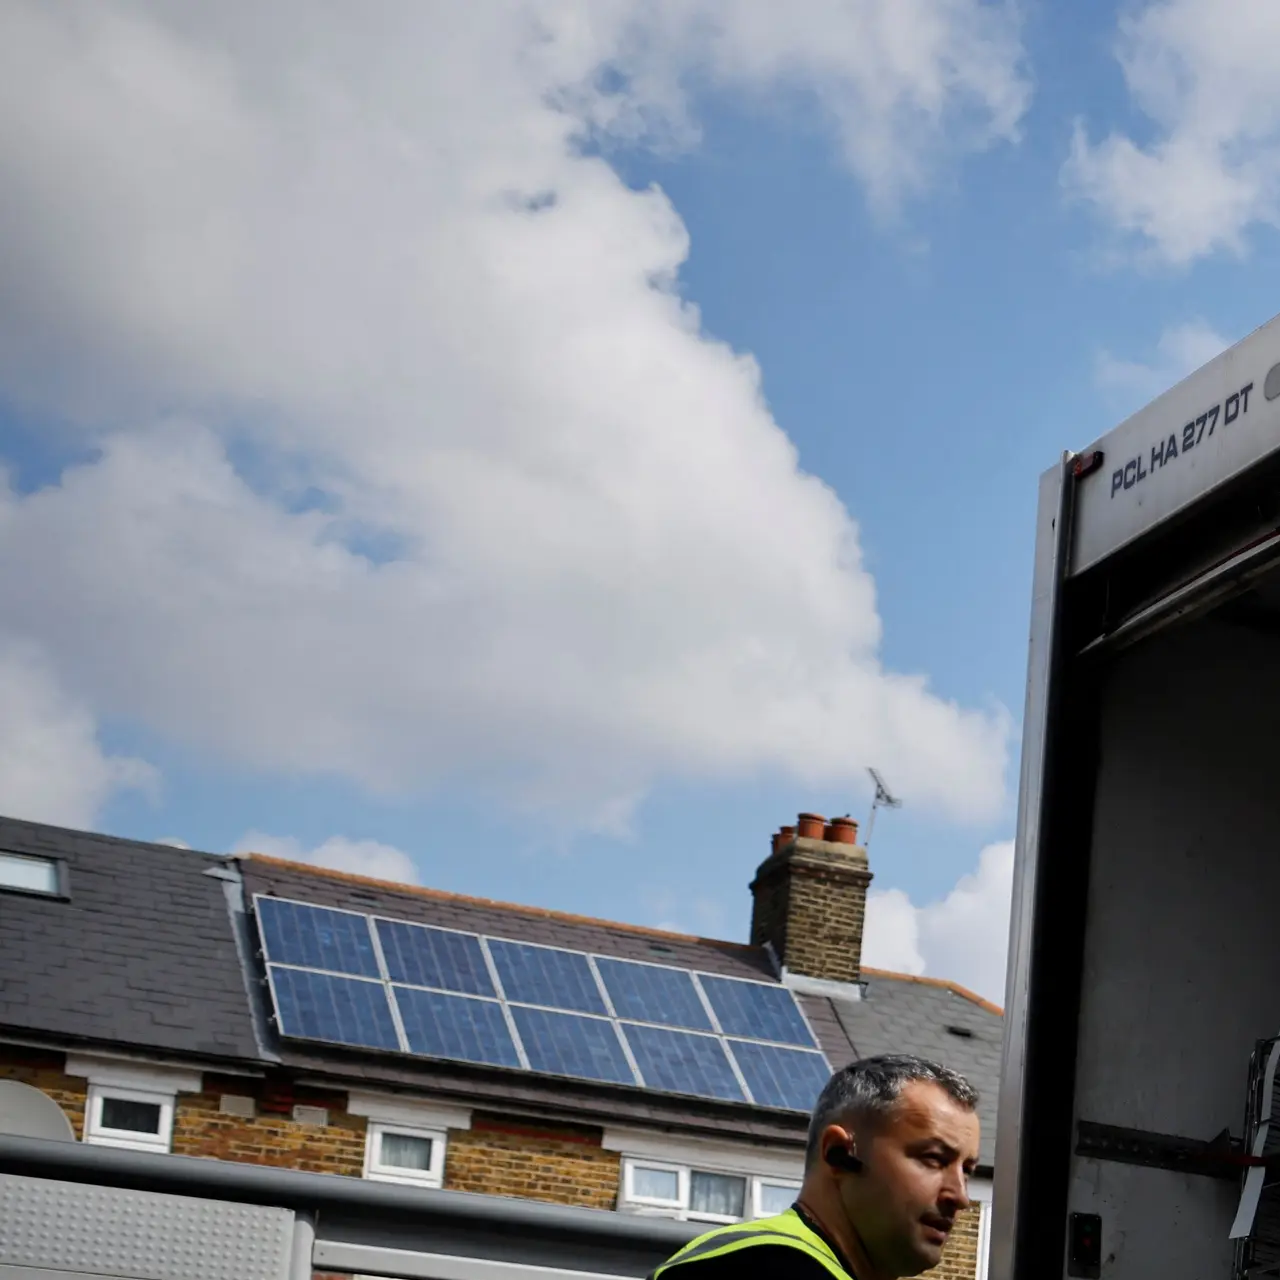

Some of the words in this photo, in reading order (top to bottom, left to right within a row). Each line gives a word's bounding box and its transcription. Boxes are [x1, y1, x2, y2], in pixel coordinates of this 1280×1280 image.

[1111, 456, 1147, 499] PCL
[1151, 433, 1178, 473] HA
[1182, 405, 1220, 453] 277
[1225, 382, 1254, 425] DT
